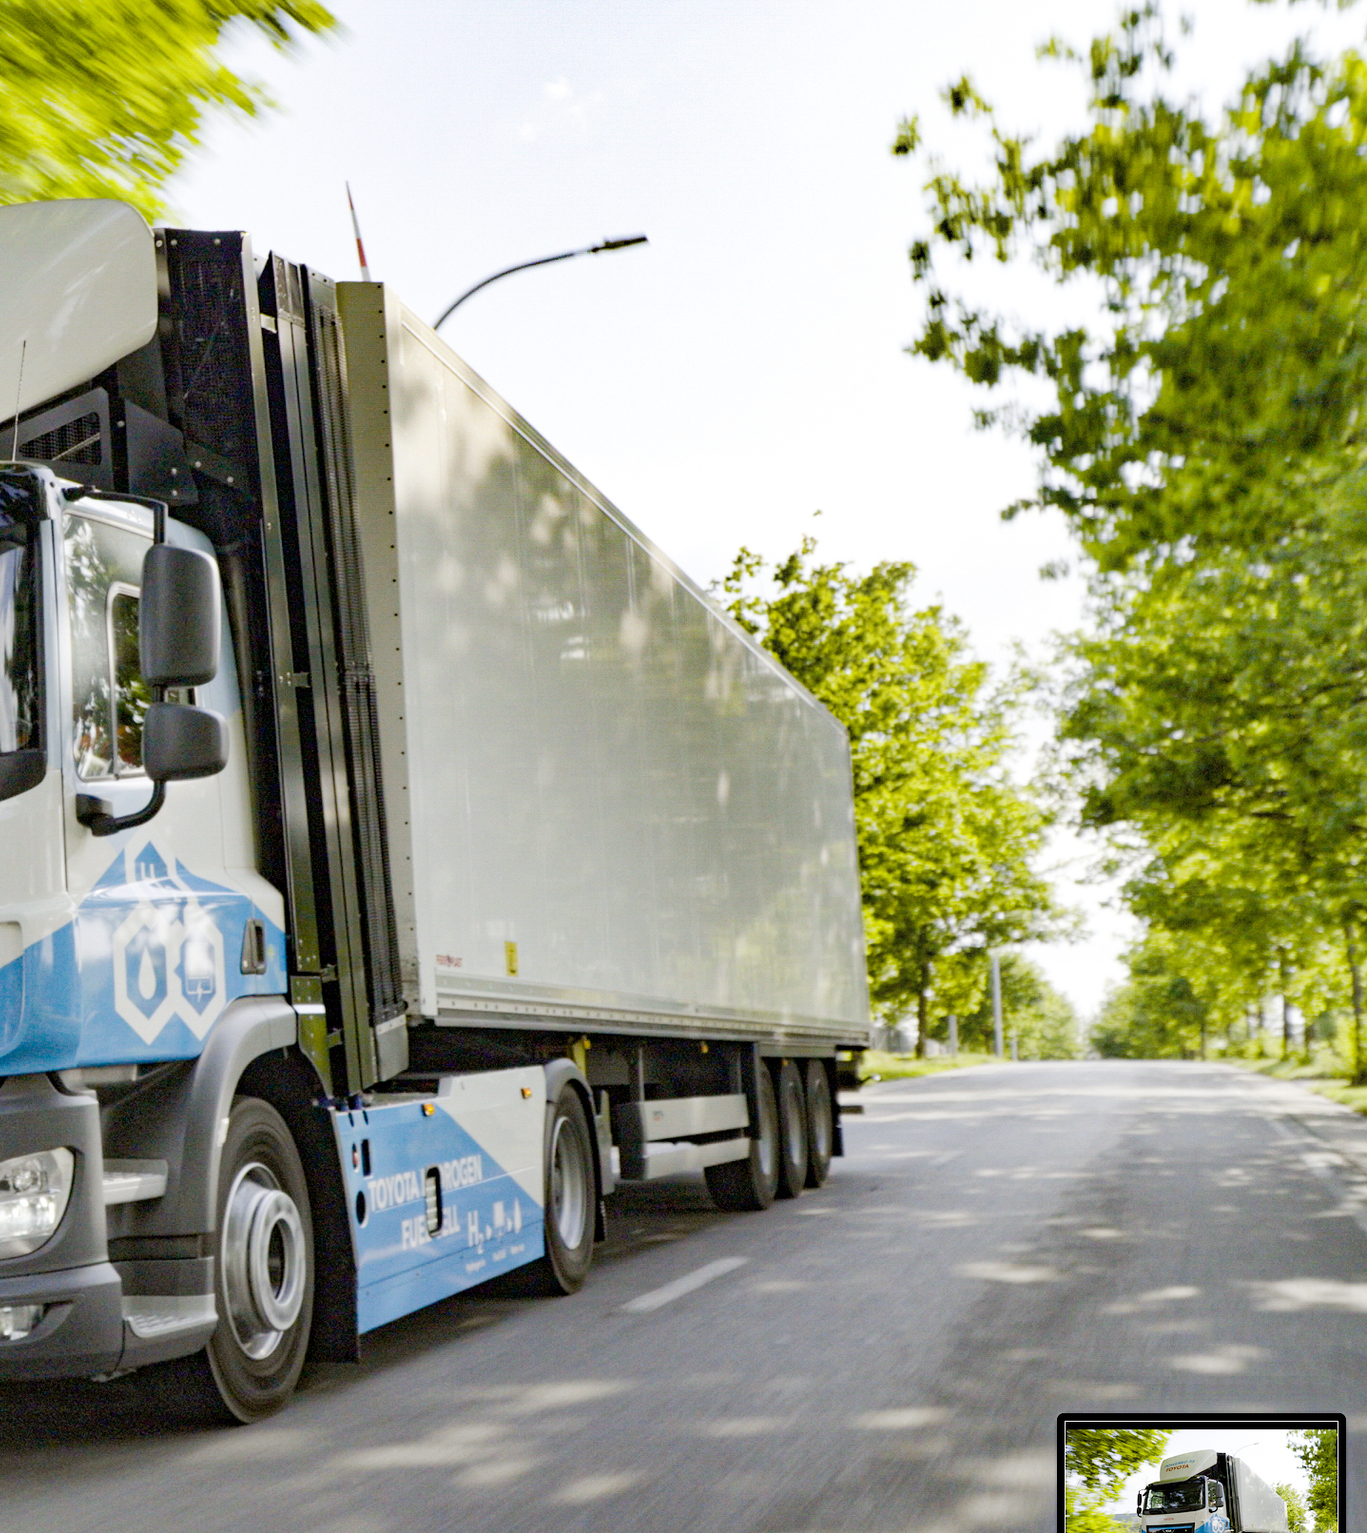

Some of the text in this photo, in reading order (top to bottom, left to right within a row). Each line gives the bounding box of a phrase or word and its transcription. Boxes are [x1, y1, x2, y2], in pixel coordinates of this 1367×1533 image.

[367, 1154, 482, 1212] TOYOTA ROGEN
[436, 1205, 461, 1239] ELL
